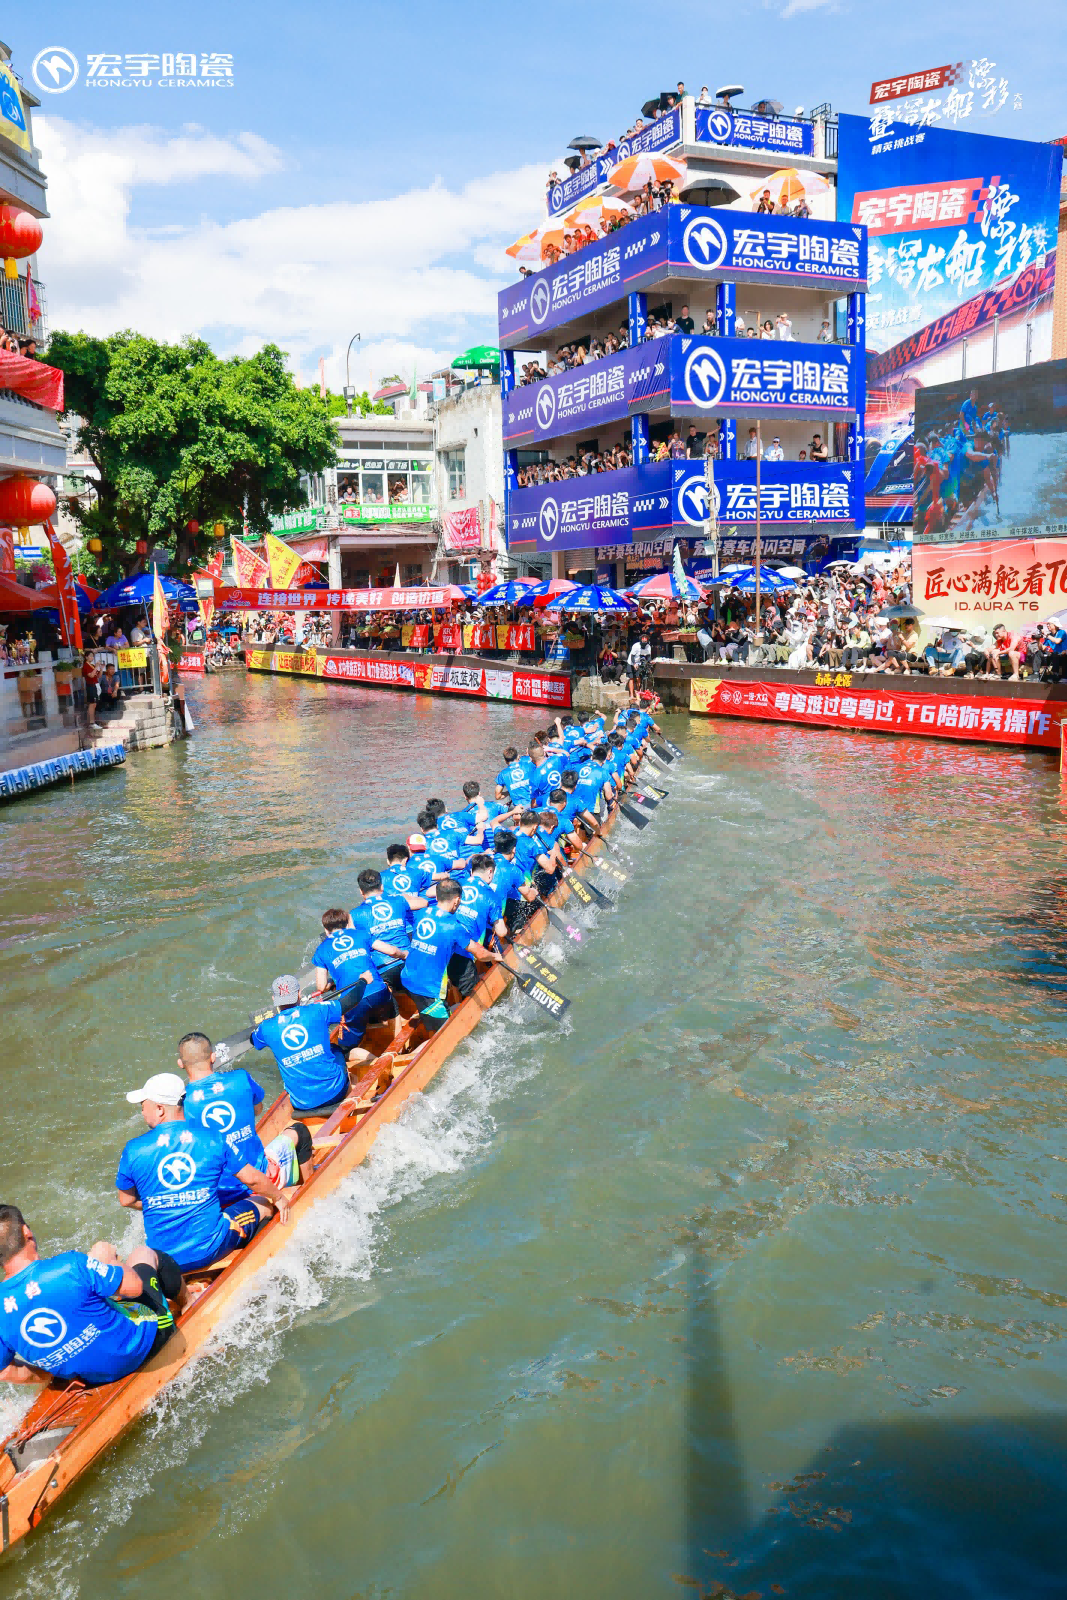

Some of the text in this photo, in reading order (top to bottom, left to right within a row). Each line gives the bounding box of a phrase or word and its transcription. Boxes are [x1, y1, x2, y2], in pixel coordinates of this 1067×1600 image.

[631, 115, 675, 156] 宏宇陶瓷
[651, 131, 675, 150] CERAMICS
[733, 118, 804, 143] 宏宇陶瓷
[733, 132, 803, 149] HONGYU CERAMICS
[563, 162, 598, 196] 宏宇陶瓷
[857, 187, 968, 231] 宏宇陶瓷
[732, 229, 861, 266] 宏宇陶瓷
[551, 247, 620, 300] 宏宇陶瓷
[732, 256, 860, 278] HONGYU CERAMICS
[552, 272, 620, 312] HONGYU CERAMICS
[557, 364, 625, 409] 宏宇陶瓷
[731, 358, 849, 394] 宏宇陶瓷
[557, 391, 625, 419] HONGYU CERAMICS
[731, 389, 849, 406] HONGYU CERAMICS
[560, 491, 629, 524] 宏宇陶瓷
[726, 482, 850, 510] 宏宇陶瓷
[560, 516, 629, 534] HONGYU CERAMICS
[726, 508, 850, 521] HONGYU CERAMICS
[597, 539, 675, 560] 宏宇赛车快闪空间
[257, 592, 317, 606] 连接世界
[326, 592, 383, 606] 传递美好
[391, 590, 445, 606] 创造价值
[1018, 602, 1039, 611] T6
[530, 986, 561, 1014] HIUYE
[69, 1330, 101, 1359] CERAMIC
